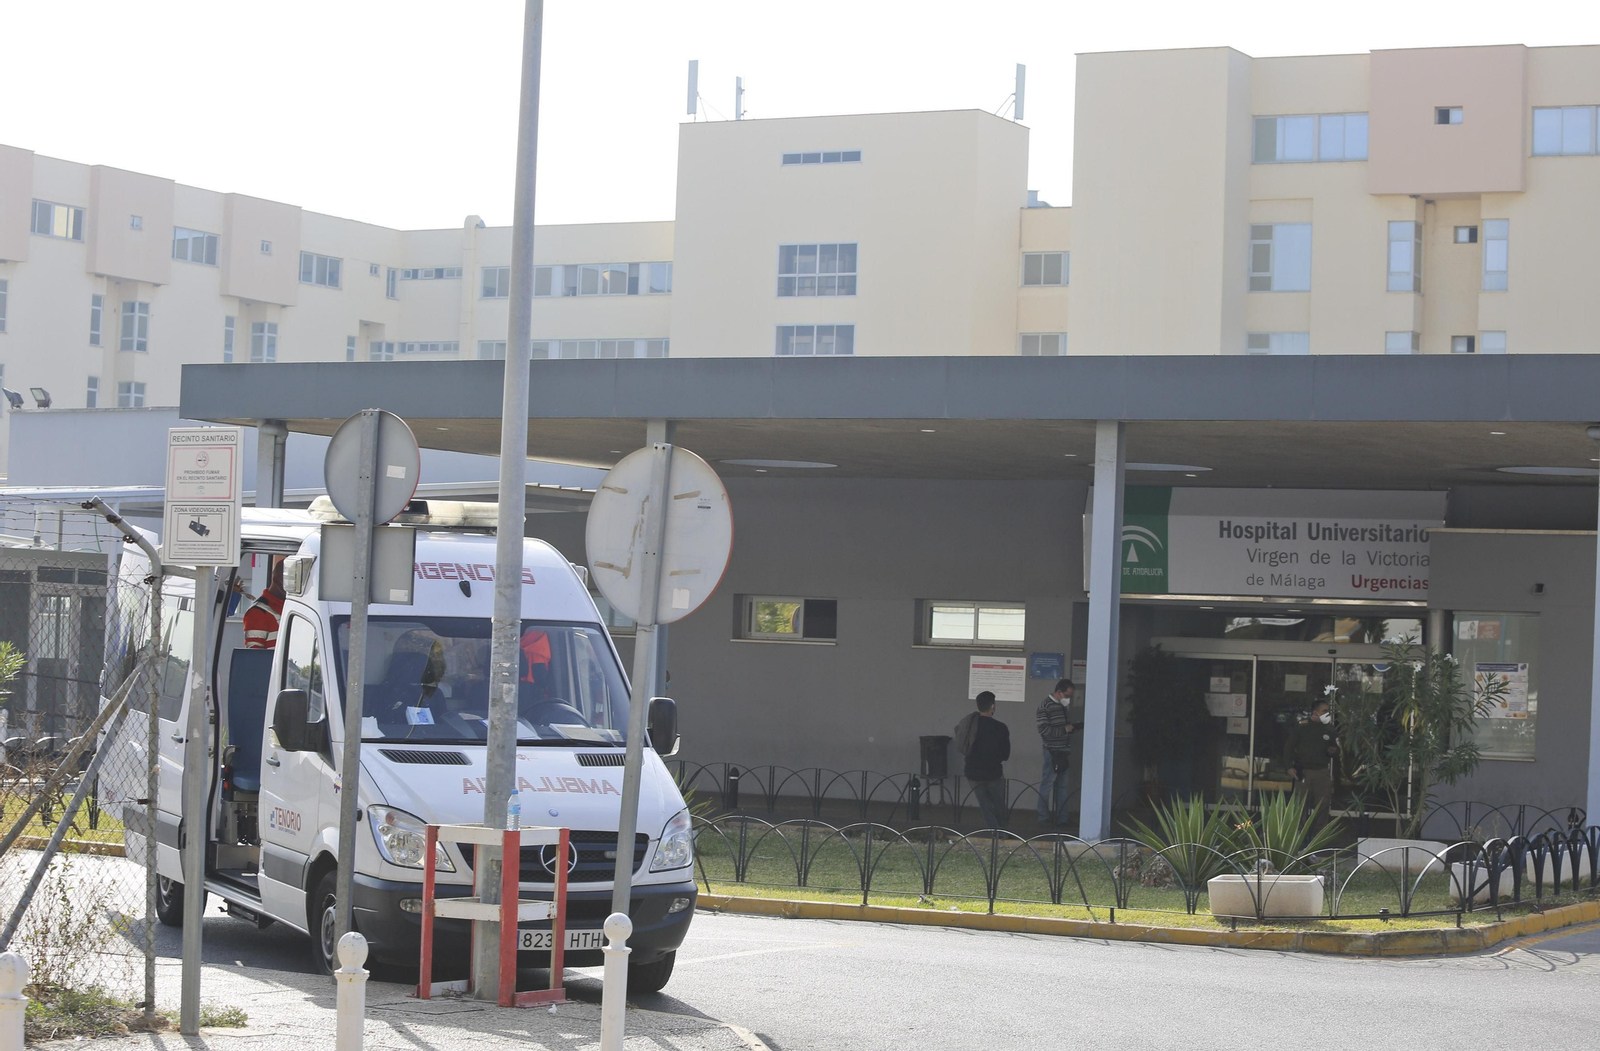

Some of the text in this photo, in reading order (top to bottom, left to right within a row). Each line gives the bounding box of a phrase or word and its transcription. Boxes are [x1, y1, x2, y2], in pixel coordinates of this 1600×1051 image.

[201, 434, 236, 442] SANITARIO
[1219, 520, 1430, 543] Hospital Universitario
[1246, 548, 1430, 567] Virgen de la Victoria
[1246, 573, 1429, 592] de Málaga Urgencias
[274, 806, 302, 832] TENORIO
[523, 932, 601, 948] 823 HTH
